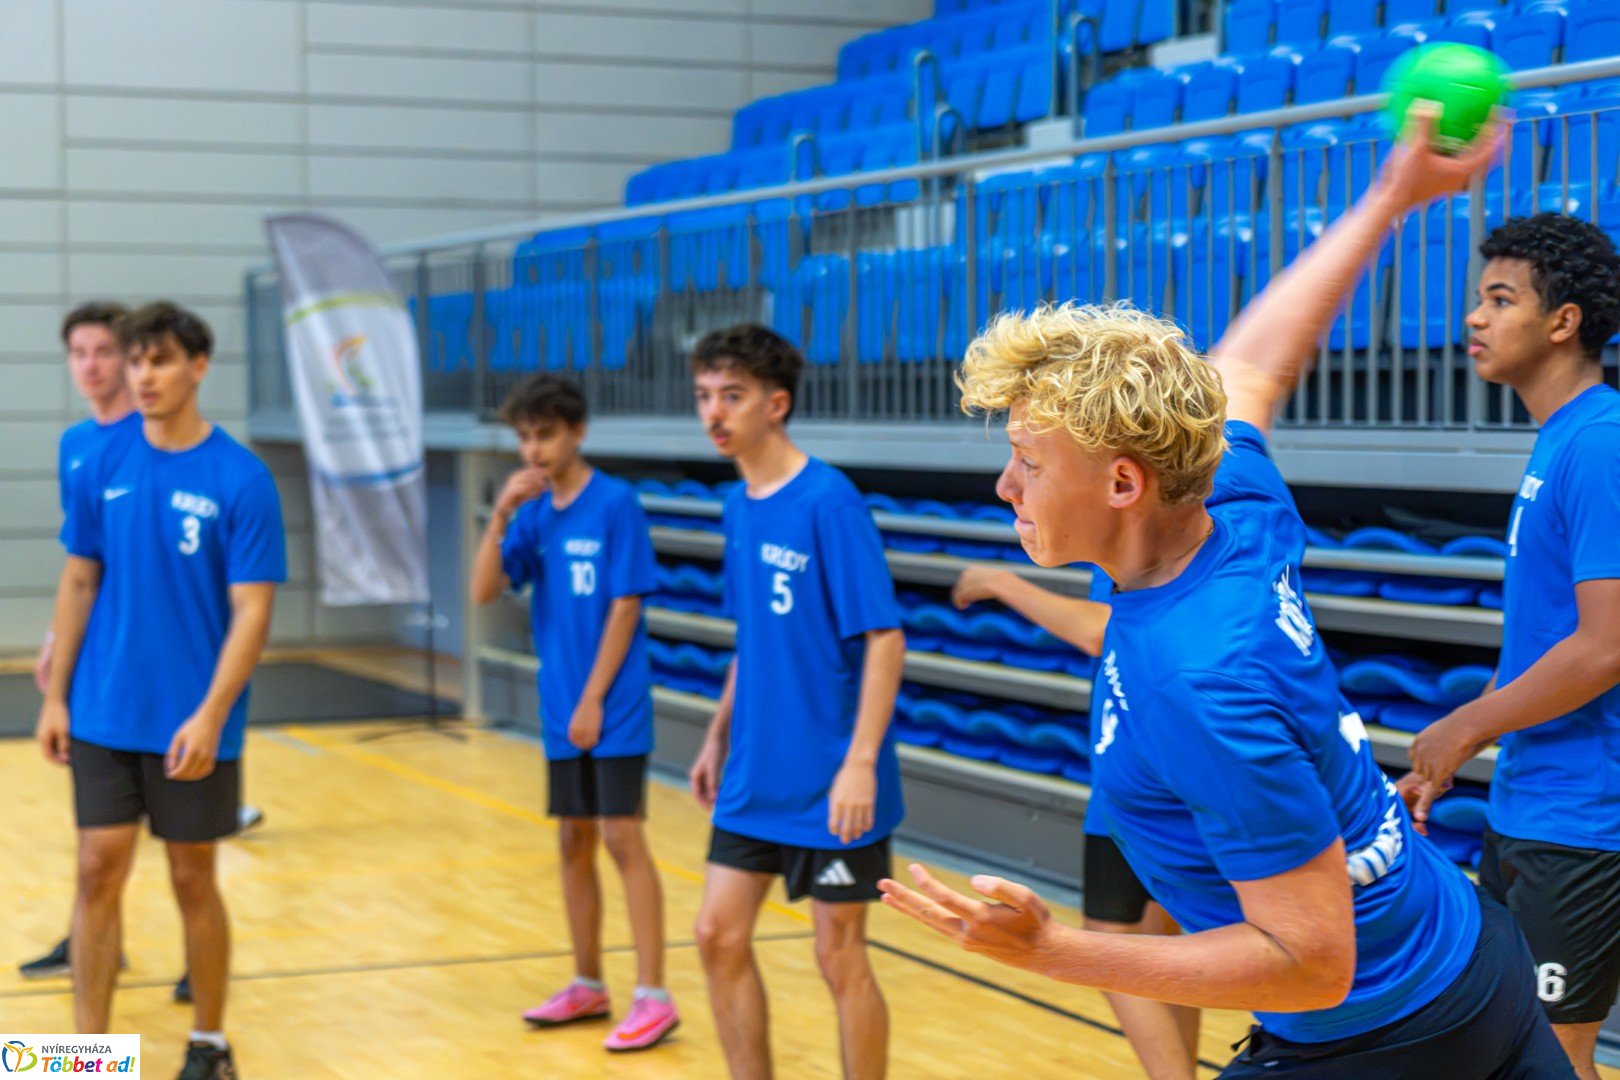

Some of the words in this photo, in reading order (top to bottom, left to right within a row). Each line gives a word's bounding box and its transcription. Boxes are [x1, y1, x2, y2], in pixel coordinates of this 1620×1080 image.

[179, 515, 200, 555] 3
[569, 561, 596, 596] 10
[770, 571, 794, 616] 5
[1533, 962, 1567, 1002] 6
